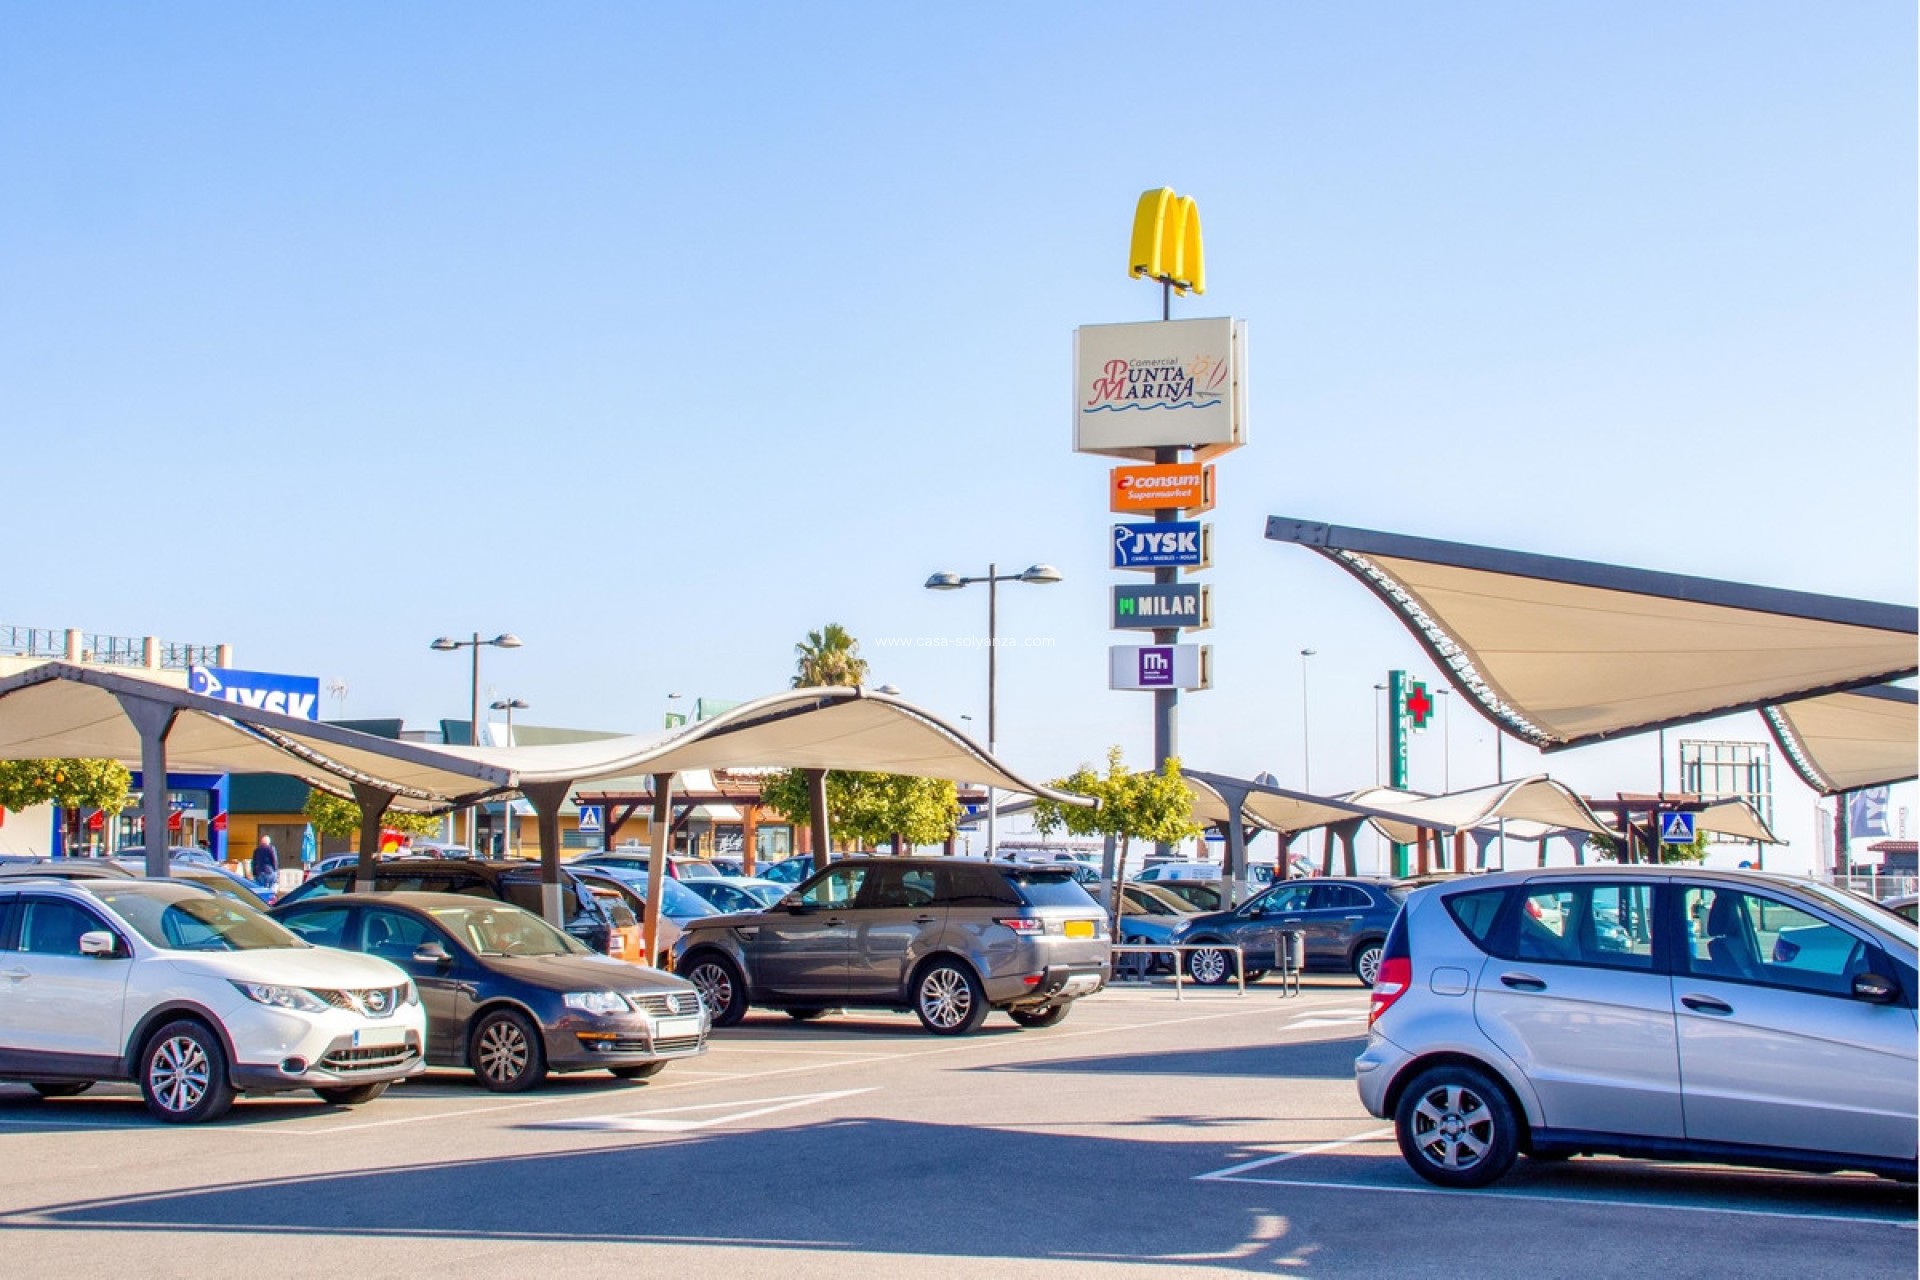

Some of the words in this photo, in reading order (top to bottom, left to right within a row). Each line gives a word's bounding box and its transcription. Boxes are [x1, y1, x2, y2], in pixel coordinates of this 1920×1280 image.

[1104, 359, 1184, 384] PUNTA
[1129, 357, 1178, 367] Comercial
[1088, 377, 1194, 405] MARINA
[1135, 474, 1200, 488] consum
[1127, 488, 1192, 501] Supermarket
[1132, 532, 1197, 553] JYSK
[1138, 595, 1196, 616] MILAR
[1866, 786, 1887, 833] JYS
